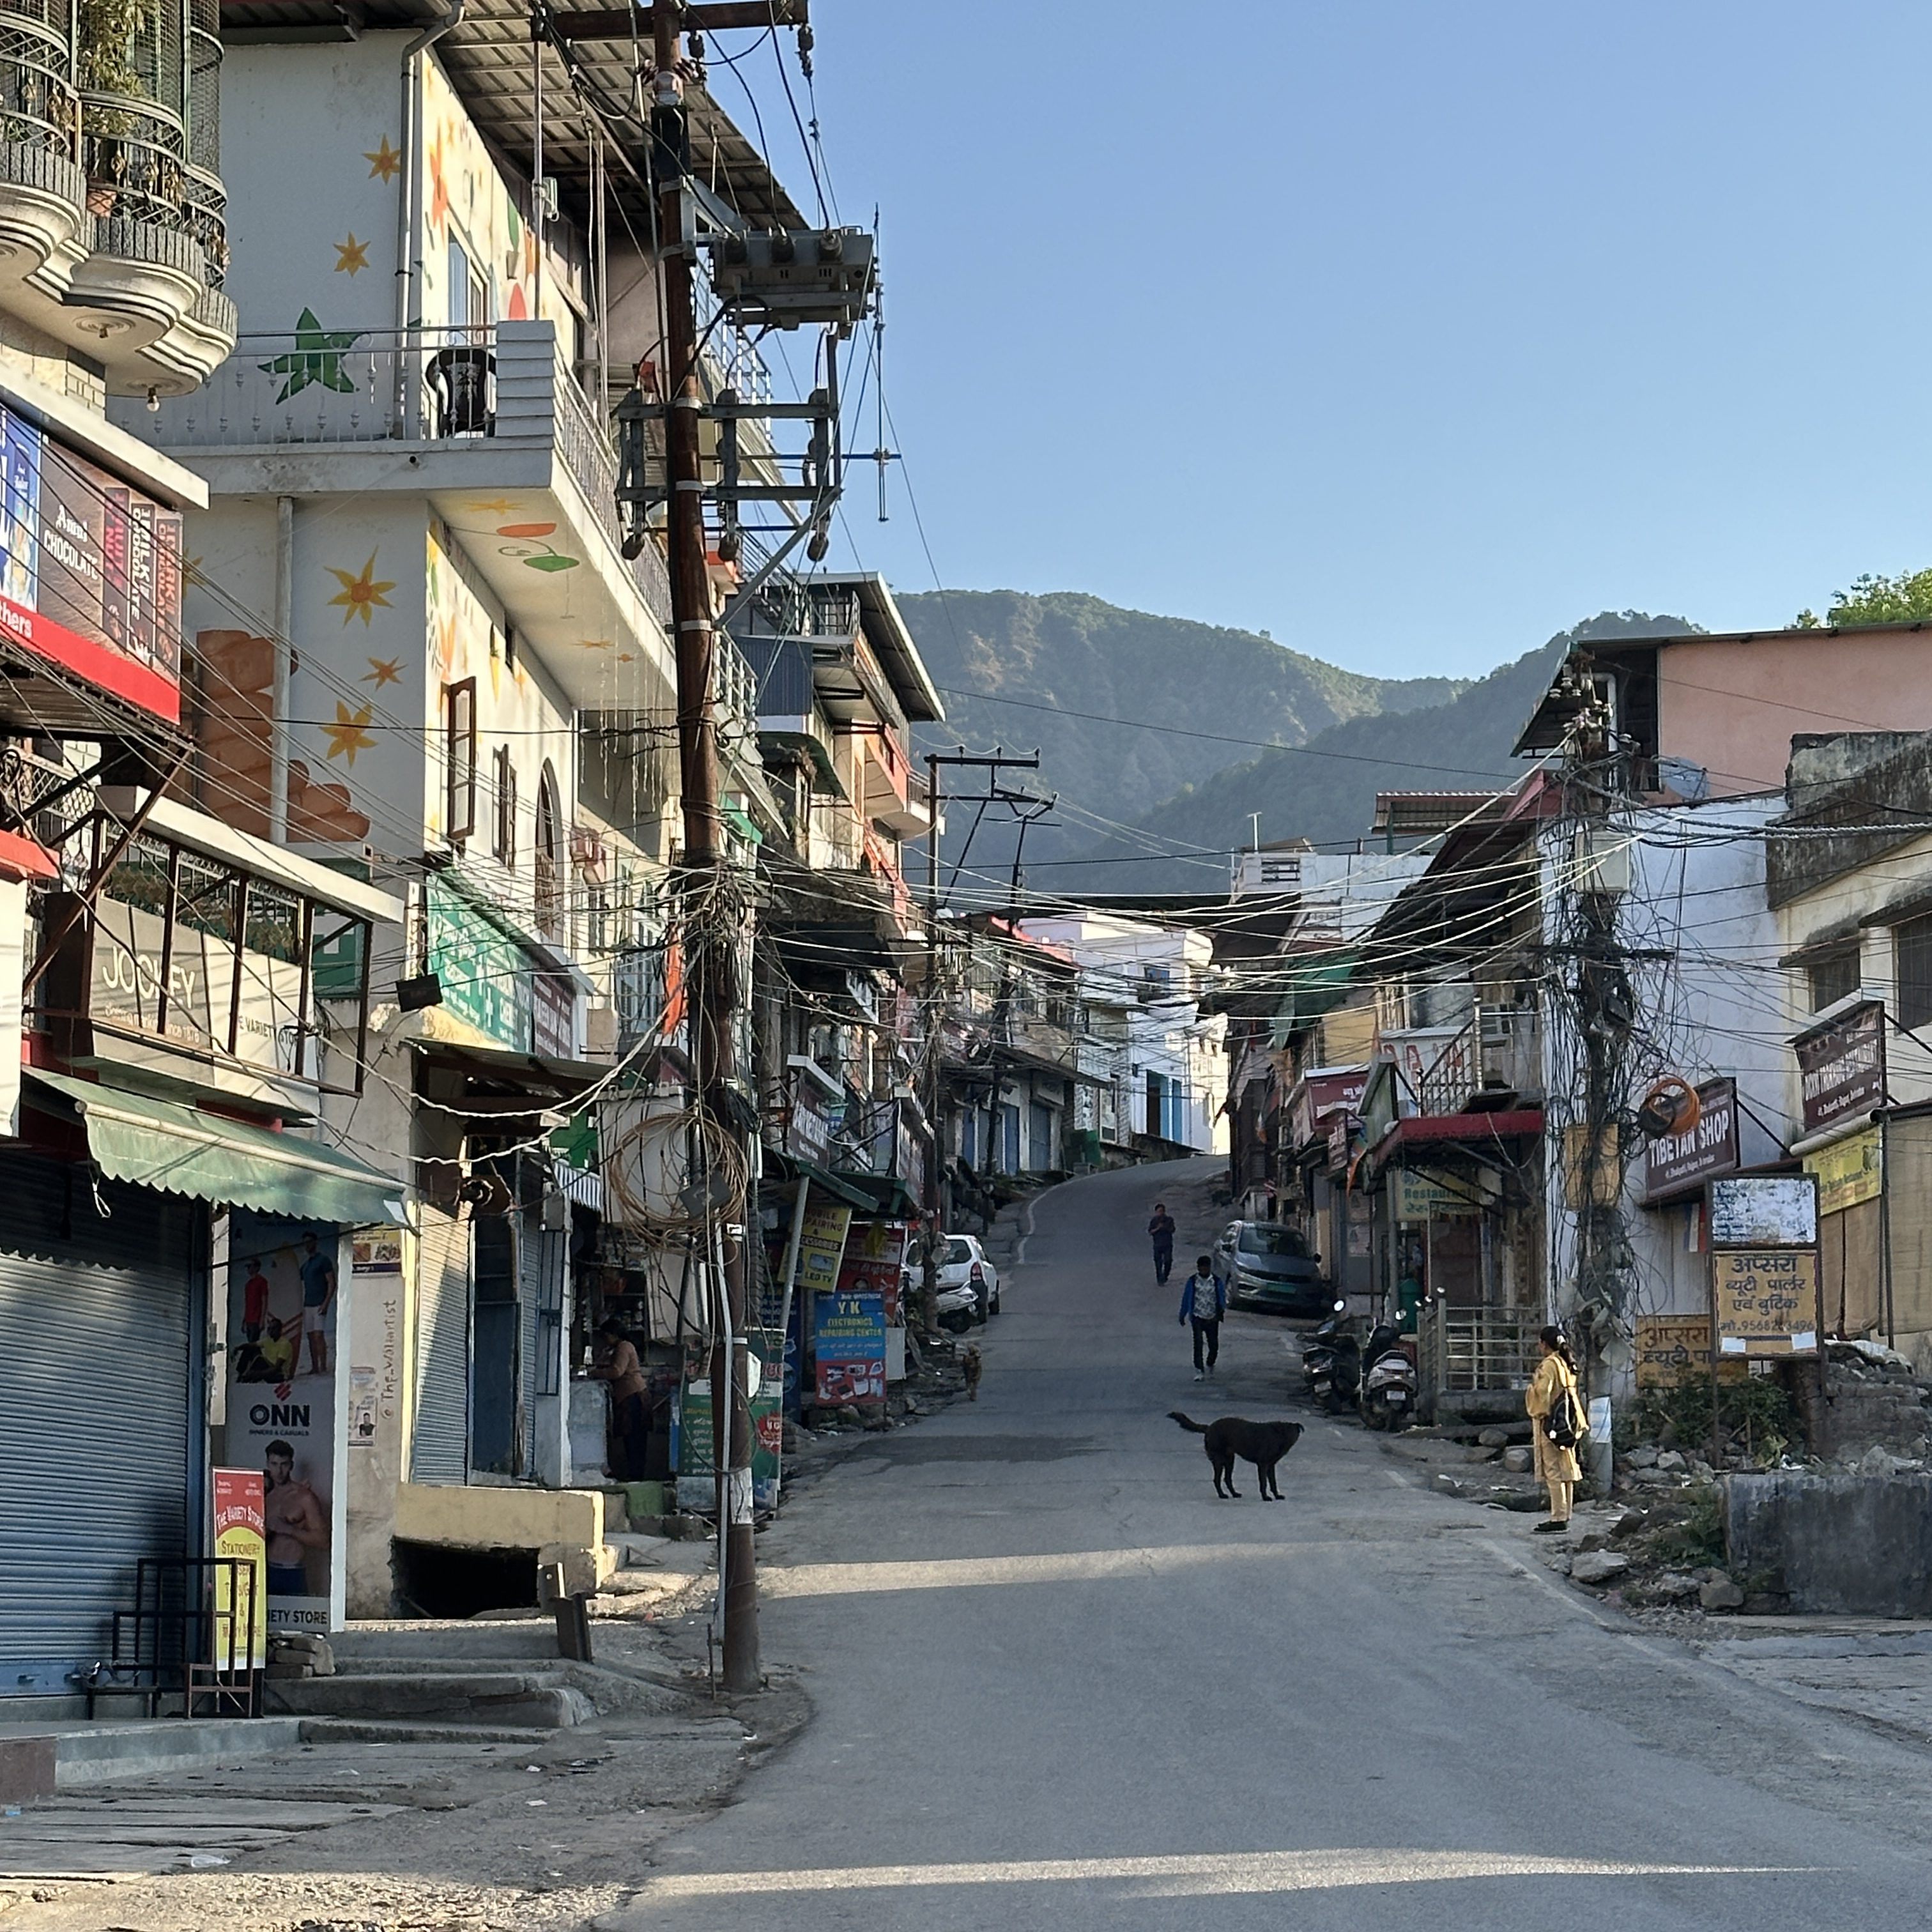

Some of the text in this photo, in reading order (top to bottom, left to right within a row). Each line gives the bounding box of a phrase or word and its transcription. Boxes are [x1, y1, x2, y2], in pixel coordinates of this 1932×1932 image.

[43, 530, 98, 580] CHOCOLATE
[1648, 1129, 1696, 1169] TIBETAN
[1699, 1110, 1729, 1149] SHOP
[1731, 1257, 1798, 1273] अप्सरा
[250, 1404, 310, 1427] ONN
[293, 1610, 328, 1625] STORE
